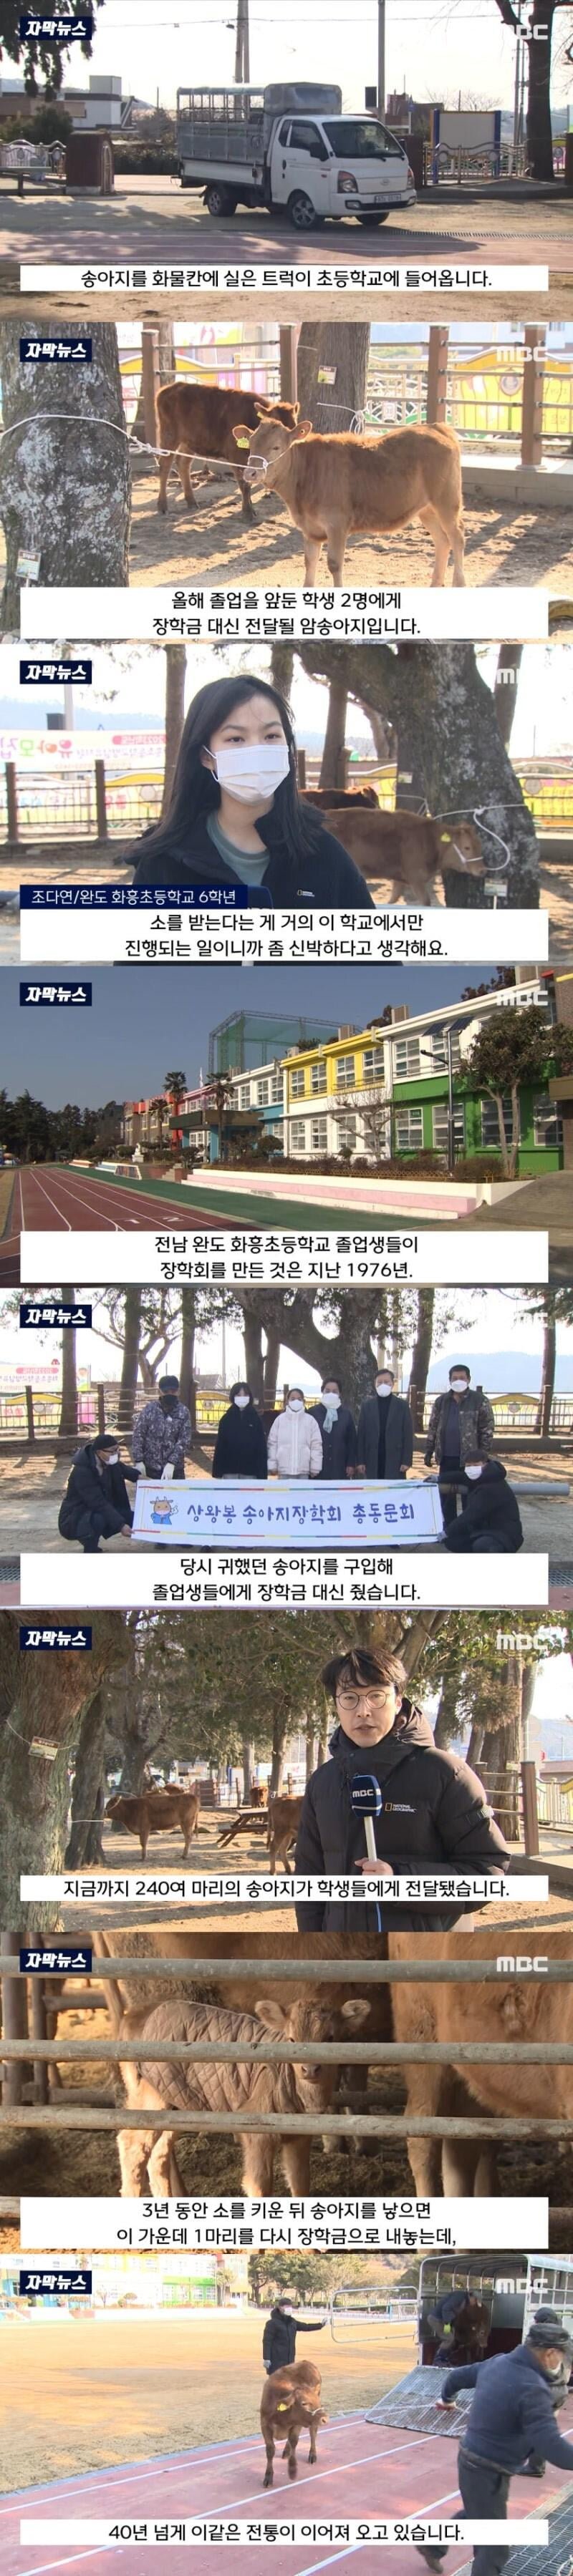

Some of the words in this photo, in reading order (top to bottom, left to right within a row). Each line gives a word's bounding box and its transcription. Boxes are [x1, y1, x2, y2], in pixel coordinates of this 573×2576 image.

[187, 1504, 237, 1525] 상왕봉
[242, 1503, 342, 1525] 송아지장학회
[352, 1502, 415, 1524] 총동문회
[352, 1789, 374, 1798] MBC
